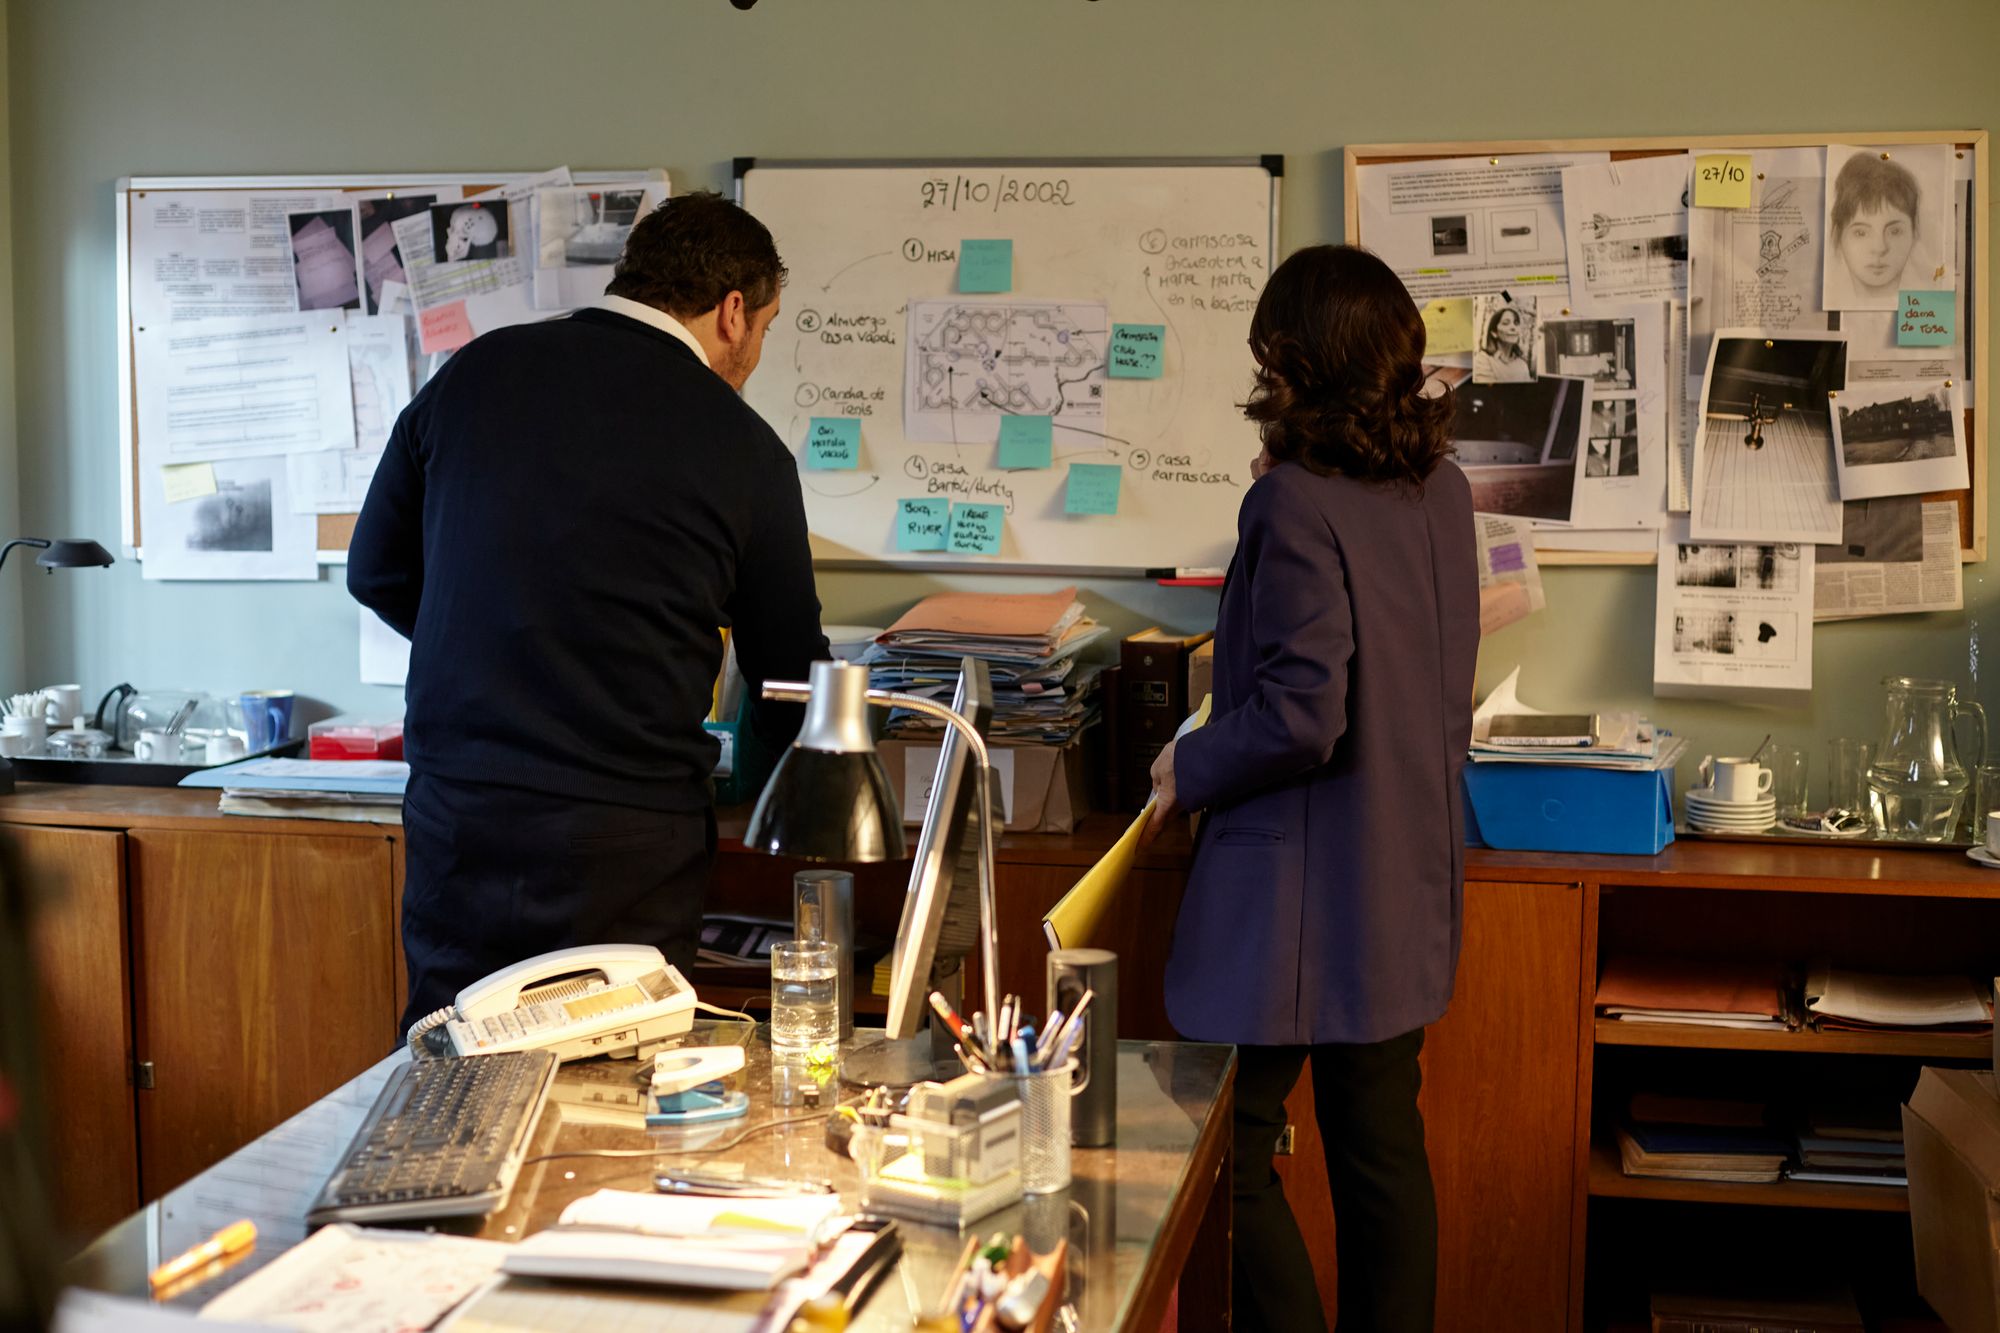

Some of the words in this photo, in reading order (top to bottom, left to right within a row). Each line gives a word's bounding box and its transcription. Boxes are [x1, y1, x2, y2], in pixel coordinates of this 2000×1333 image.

[1702, 160, 1744, 184] 27/10
[921, 175, 1075, 212] 27/10/2002
[1905, 308, 1935, 319] dama
